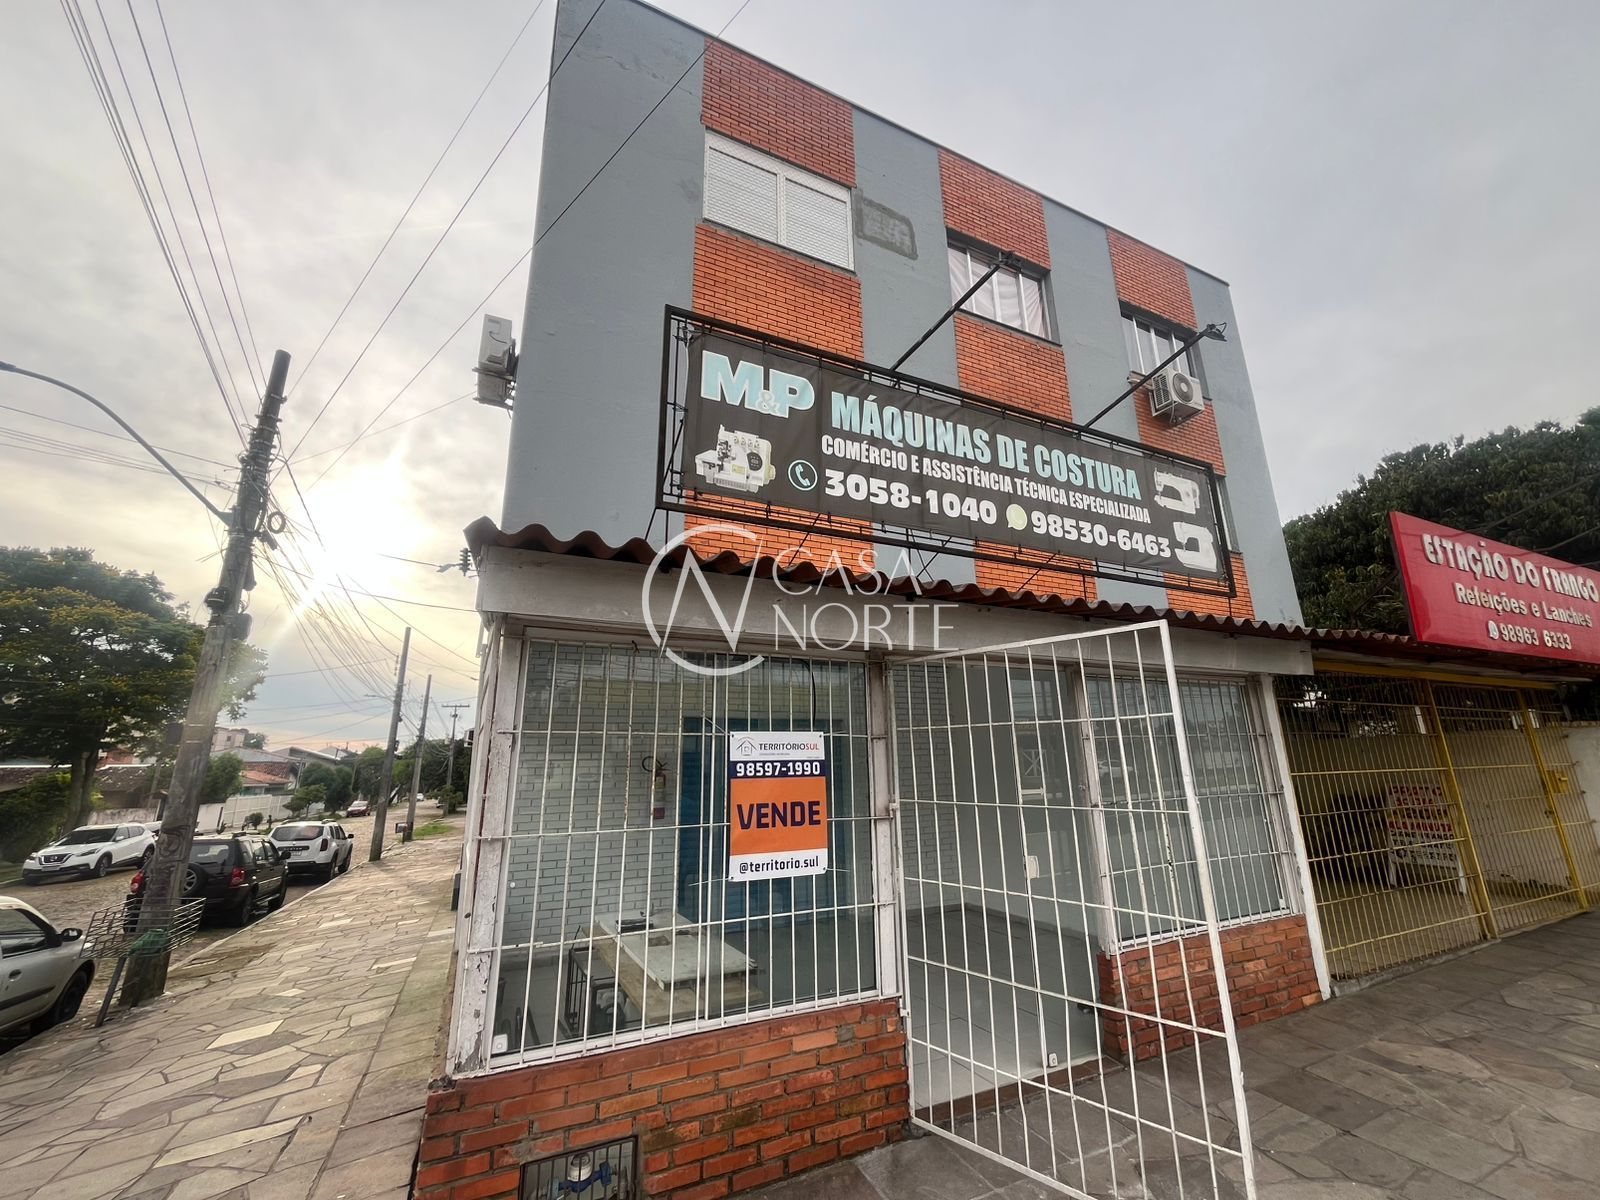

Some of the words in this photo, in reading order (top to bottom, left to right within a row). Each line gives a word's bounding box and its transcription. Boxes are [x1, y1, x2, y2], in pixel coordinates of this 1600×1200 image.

[700, 349, 815, 419] M&P
[831, 391, 992, 464] MÁQUINAS
[996, 434, 1030, 473] DE
[1033, 444, 1142, 500] COSTURA
[821, 434, 908, 471] COMÉRCIO
[911, 454, 920, 474] E
[922, 457, 1014, 494] ASSISTÊNCIA
[1014, 477, 1067, 508] TÉCNICA
[1069, 490, 1151, 524] ESPECIALIZADA
[825, 468, 998, 525] 3058-1040
[1030, 510, 1172, 558] 98530-6463
[1422, 533, 1509, 580] ESTAÇÃO
[1510, 557, 1540, 588] DO
[1542, 566, 1600, 603] FRANGO
[1454, 582, 1527, 615] Refeições
[1531, 603, 1541, 617] e
[1542, 601, 1593, 628] Lanches
[1499, 622, 1539, 646] 98963
[1543, 629, 1572, 650] 6333
[736, 761, 821, 777] 98597-1990
[736, 800, 821, 830] VENDE
[739, 855, 819, 874] @territorio.sul
